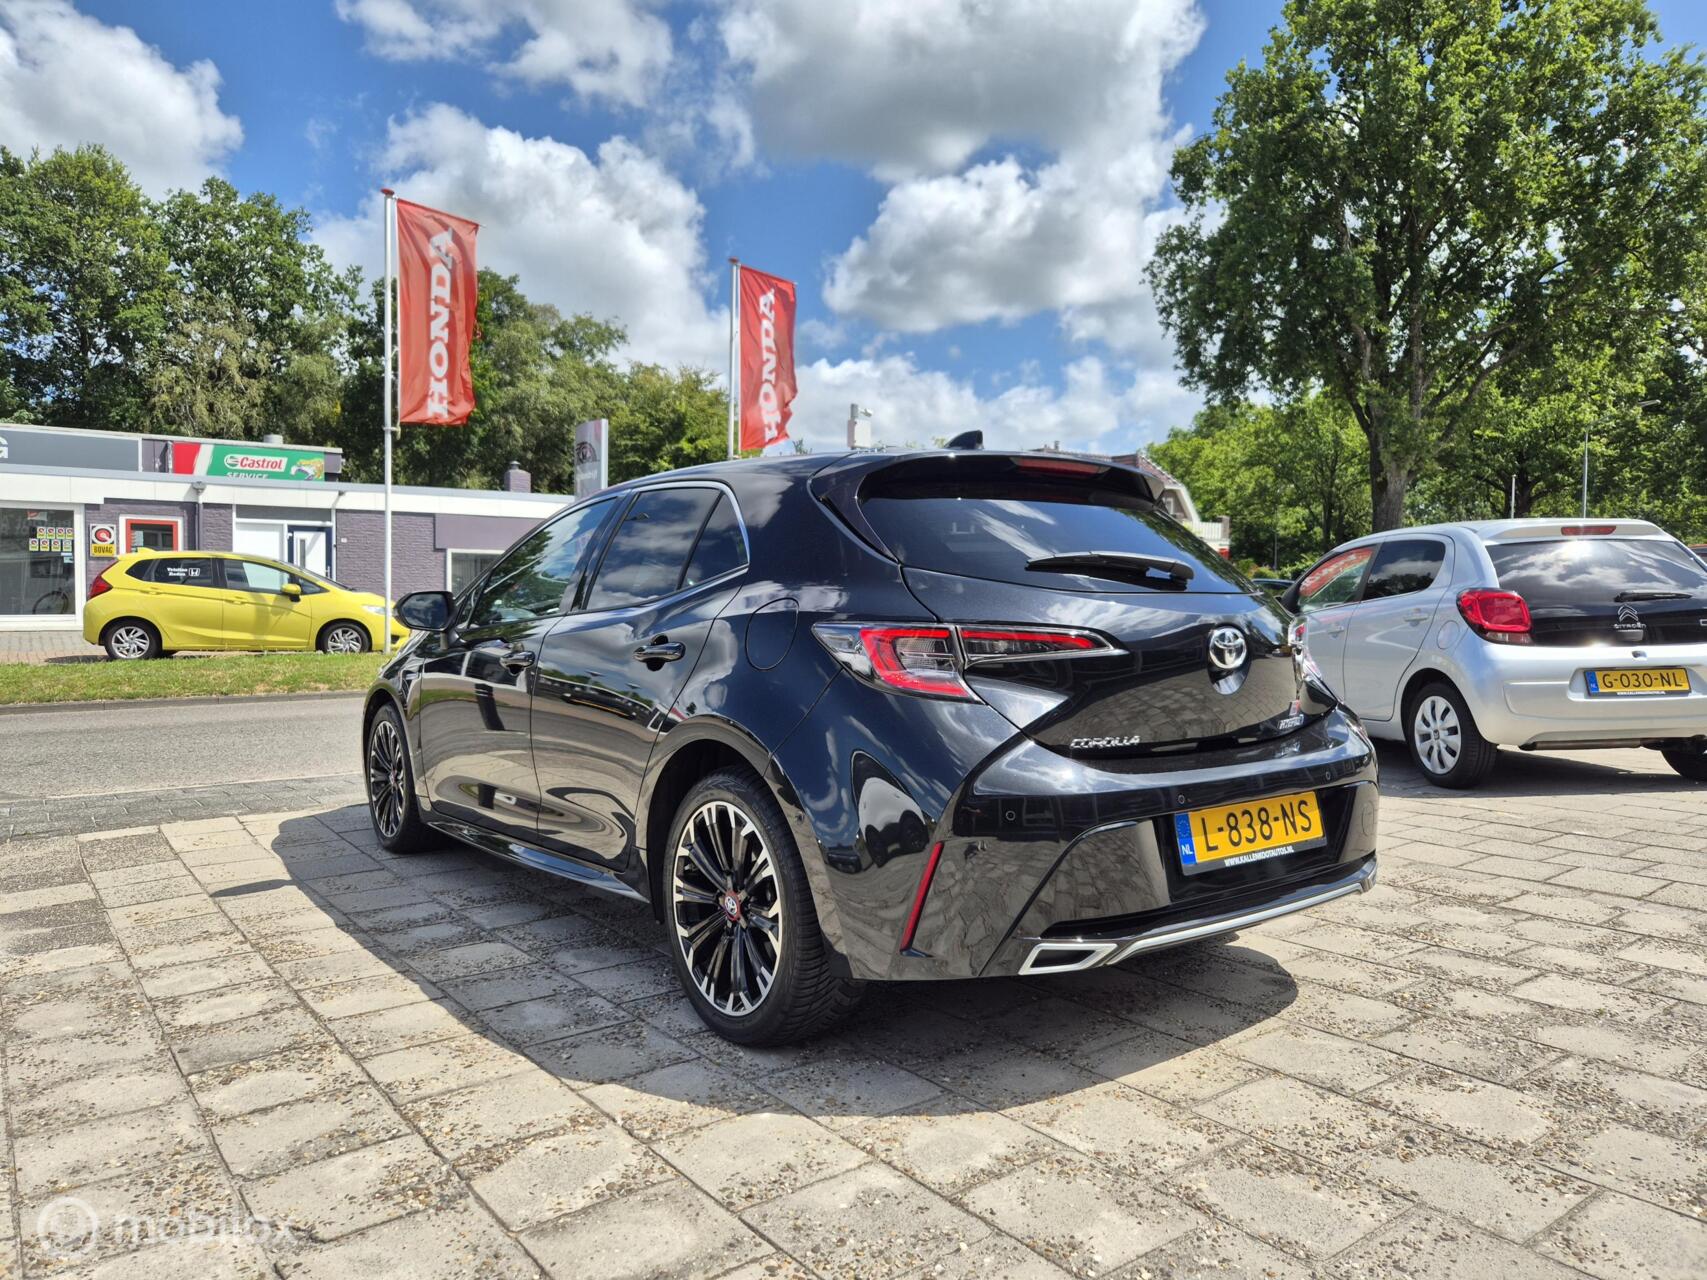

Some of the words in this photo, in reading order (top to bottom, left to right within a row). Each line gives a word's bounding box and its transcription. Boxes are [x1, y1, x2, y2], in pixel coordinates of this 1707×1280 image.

[427, 227, 454, 419] HONDA
[758, 288, 779, 442] HONDA
[239, 456, 284, 470] Castrol
[93, 545, 113, 554] BOVAG
[1602, 672, 1683, 689] G-030-NL
[1201, 799, 1312, 852] L-838-NS
[1181, 843, 1193, 855] NL
